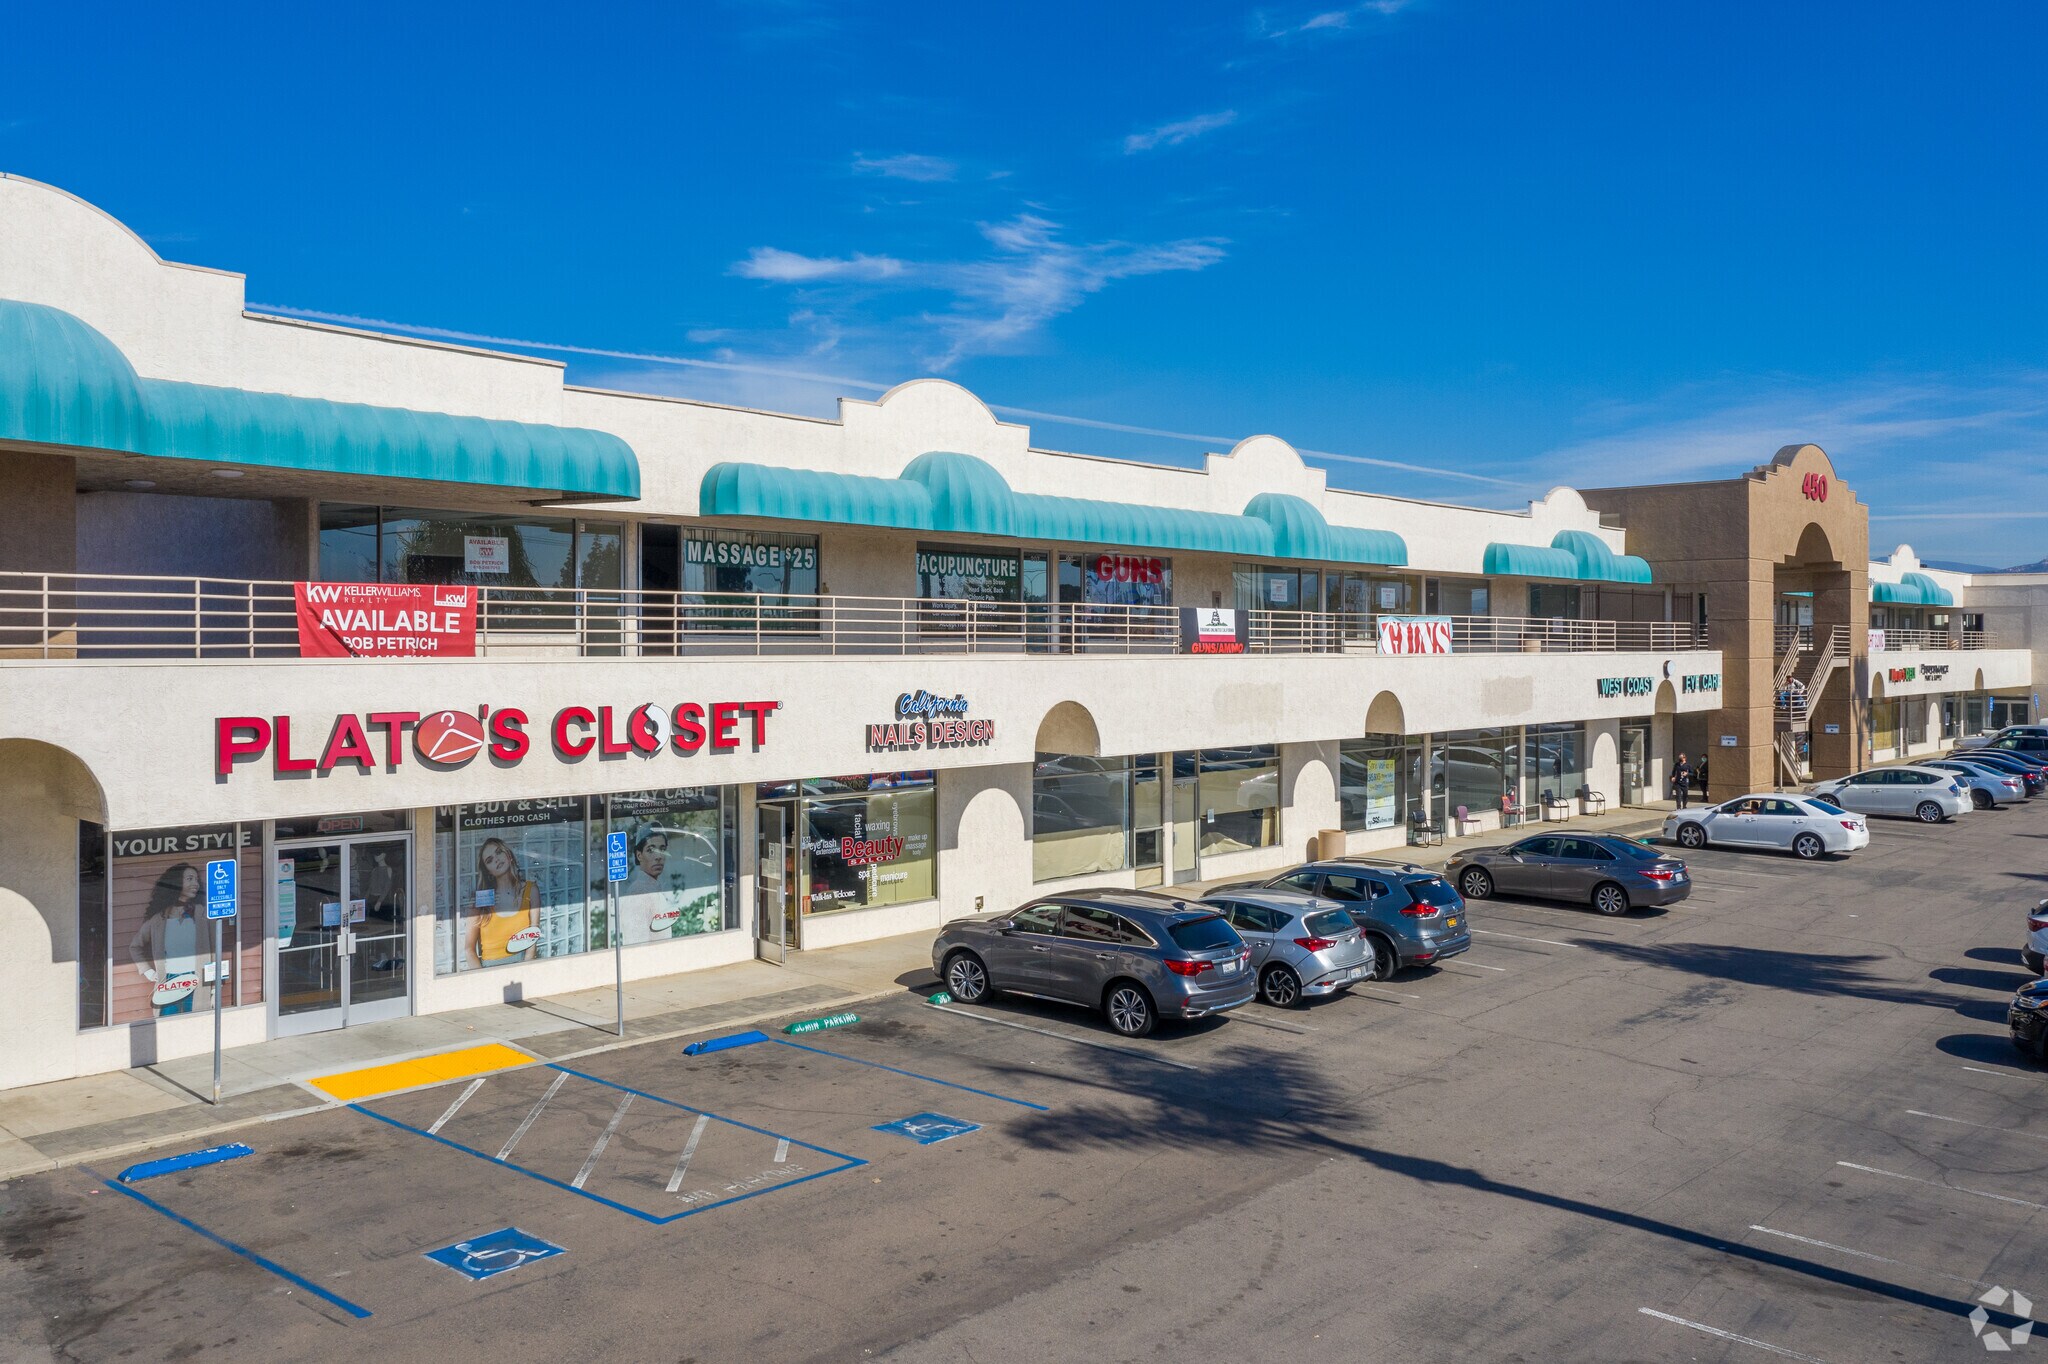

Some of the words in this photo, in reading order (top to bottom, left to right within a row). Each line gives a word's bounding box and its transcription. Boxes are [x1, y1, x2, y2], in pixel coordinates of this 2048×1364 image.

[1802, 472, 1828, 502] 450
[687, 541, 780, 567] MASSAGE
[785, 547, 814, 569] $25
[919, 554, 1016, 577] ACUPUNCTURE
[1096, 555, 1163, 584] GUNS
[446, 594, 464, 603] KW
[319, 609, 460, 633] AVAILABLE
[343, 636, 373, 650] BOB
[377, 637, 437, 650] PETRICH
[1191, 642, 1244, 654] GUNS/AMMO
[1601, 679, 1623, 694] WEST
[1627, 677, 1654, 693] COAST
[1686, 676, 1700, 691] EYE
[1703, 674, 1721, 689] CARE
[900, 690, 969, 719] California
[218, 703, 530, 775] PLATO'S
[555, 701, 779, 757] CLOSET
[871, 723, 926, 746] NAILS
[931, 720, 995, 743] DESIGN
[664, 787, 705, 799] CASH
[474, 800, 511, 815] BUY
[517, 797, 532, 811] &
[536, 796, 578, 809] SELL
[623, 802, 638, 810] YOUR
[669, 799, 684, 807] SHOES
[632, 807, 669, 816] ACCESSORIES
[320, 819, 361, 832] OPEN
[464, 815, 505, 827] CLOTHES
[507, 814, 525, 824] FOR
[527, 813, 550, 822] CASH
[854, 813, 863, 839] facial
[865, 820, 890, 832] waxing
[114, 836, 178, 856] YOUR
[186, 831, 252, 851] STYLE
[810, 841, 821, 851] eye
[823, 838, 836, 848] lash
[841, 835, 904, 859] Beauty
[905, 842, 926, 850] massage
[850, 855, 894, 865] SALON
[858, 870, 870, 880] spa
[870, 864, 878, 897] pedicure
[880, 871, 908, 882] manicure
[833, 889, 856, 898] Welcome
[824, 1013, 857, 1029] PARKING
